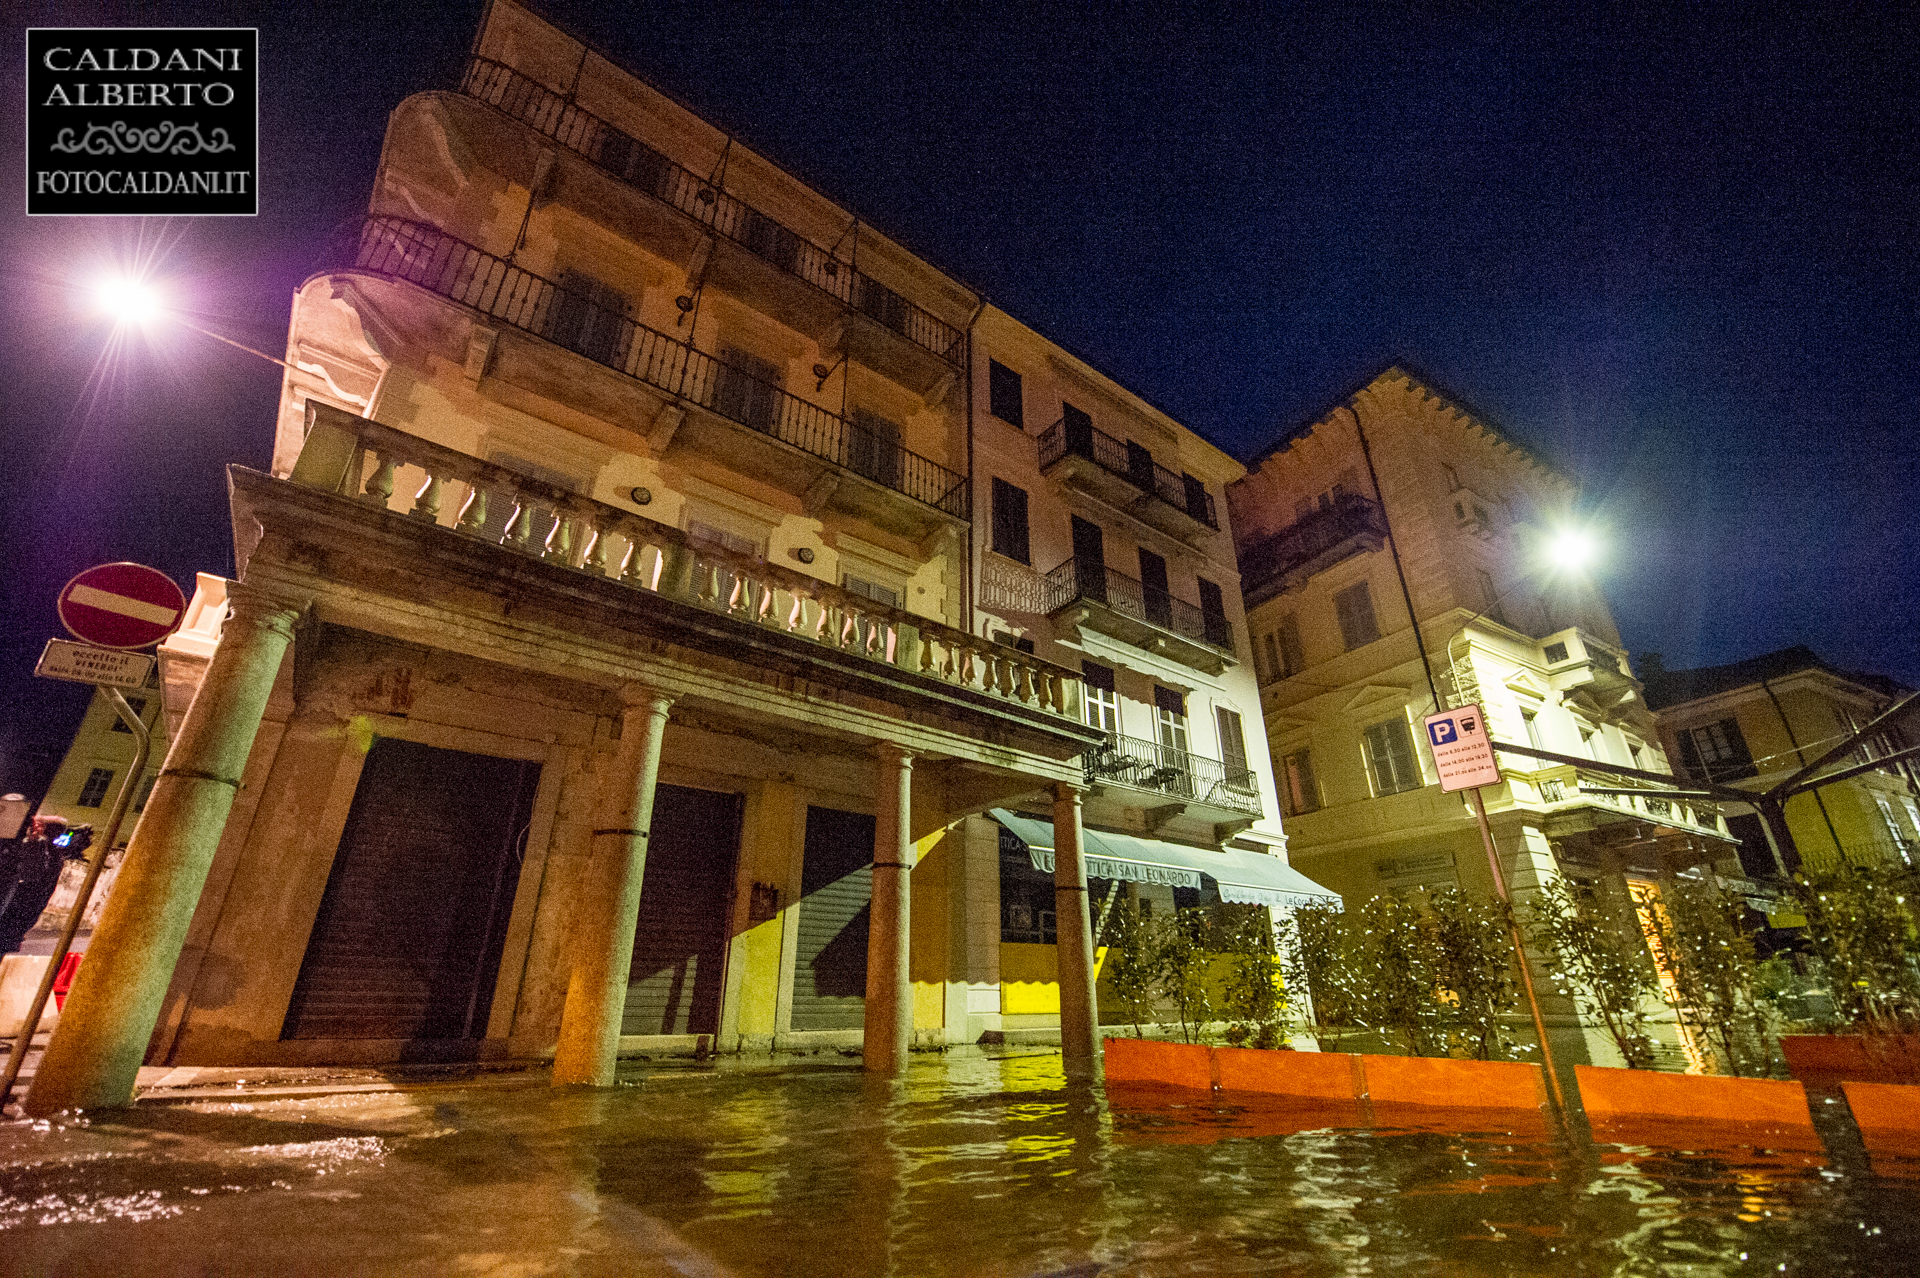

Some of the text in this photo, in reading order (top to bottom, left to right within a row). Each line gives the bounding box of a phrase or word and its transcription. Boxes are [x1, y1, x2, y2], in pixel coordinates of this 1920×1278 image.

[1434, 723, 1450, 743] P
[1119, 864, 1139, 879] SAN
[1142, 867, 1191, 885] LEONARDO
